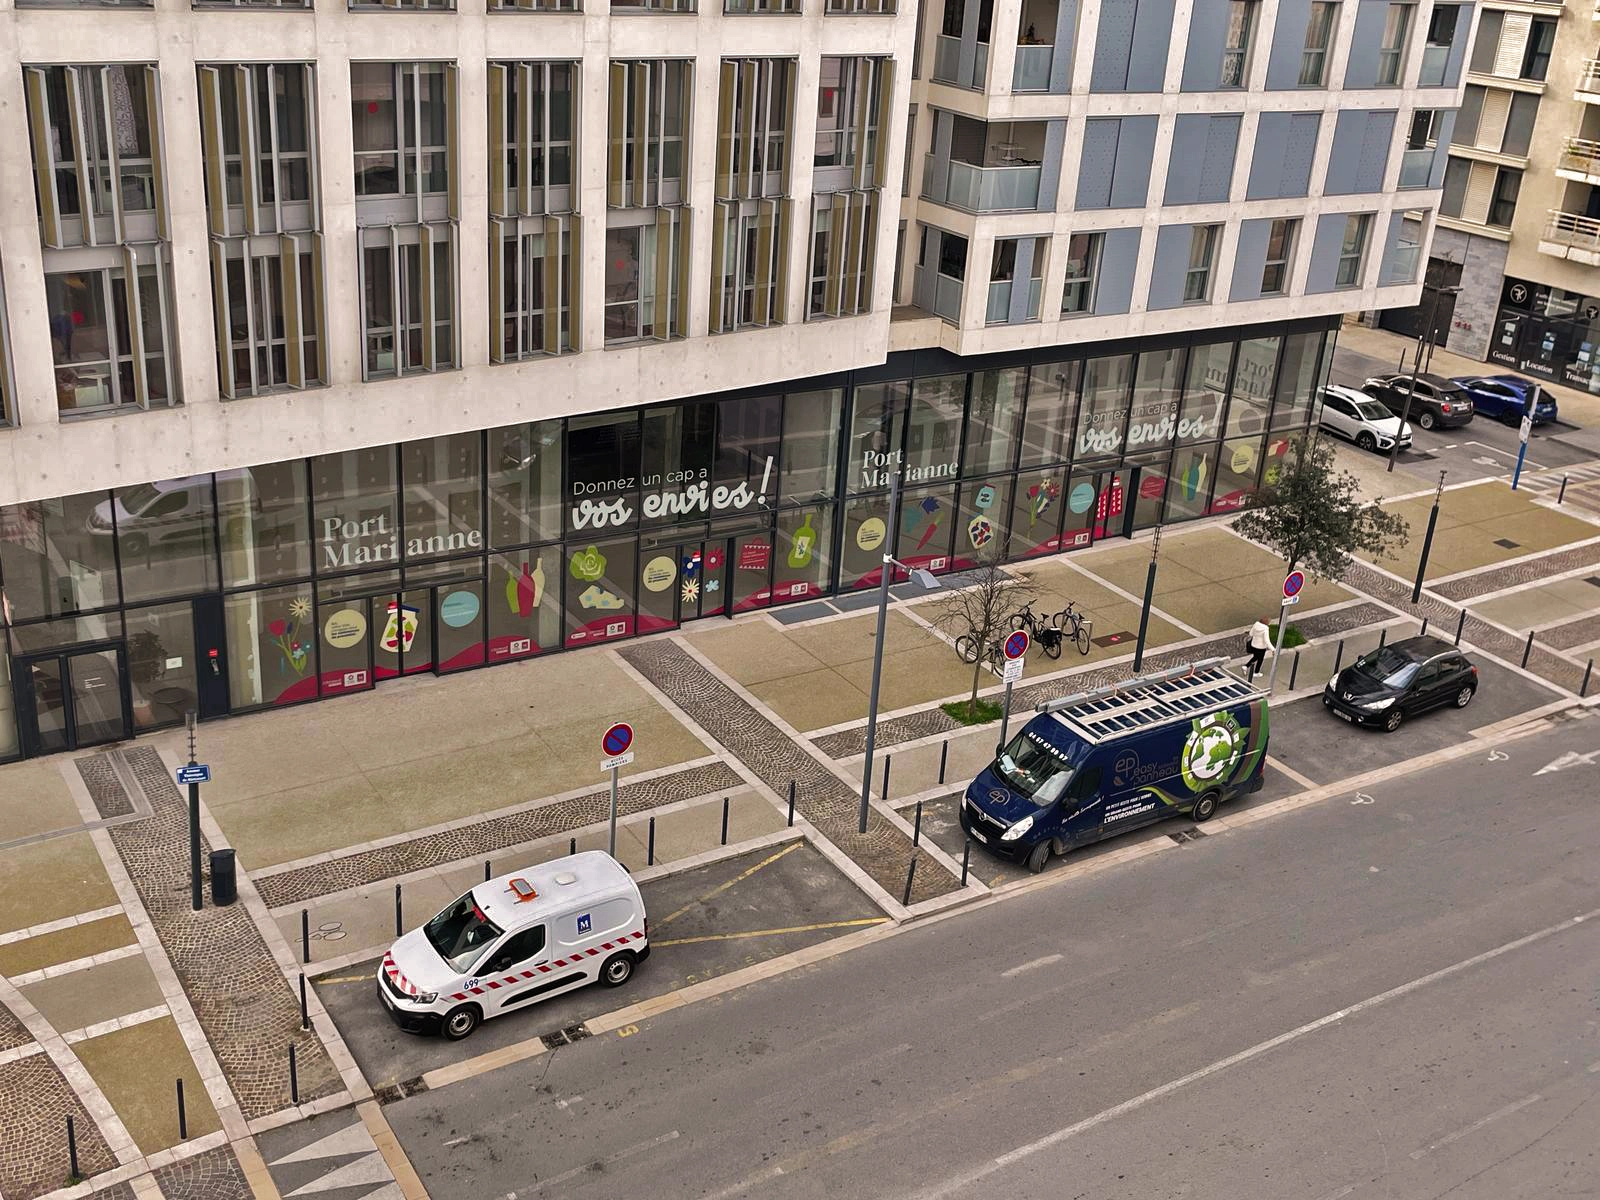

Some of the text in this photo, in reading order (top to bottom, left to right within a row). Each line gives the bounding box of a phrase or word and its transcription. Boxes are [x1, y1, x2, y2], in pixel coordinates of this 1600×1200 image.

[1492, 350, 1516, 363] Gestion
[1526, 359, 1553, 374] Location
[1083, 409, 1127, 425] Donnez
[1130, 406, 1145, 417] un
[1147, 403, 1168, 417] cap
[1079, 425, 1122, 454] vos
[1126, 413, 1207, 445] envies
[863, 448, 904, 469] Port
[573, 477, 635, 496] Donnez
[642, 473, 661, 486] un
[666, 469, 694, 484] cap
[571, 497, 633, 530] vos
[643, 480, 755, 519] envies
[322, 513, 389, 542] Port
[322, 528, 482, 569] Marianne
[1133, 761, 1158, 776] easy
[1133, 766, 1179, 787] panneau
[1103, 802, 1156, 824] L'ENVIRONNEMENT
[580, 919, 589, 929] M
[463, 978, 479, 990] 699
